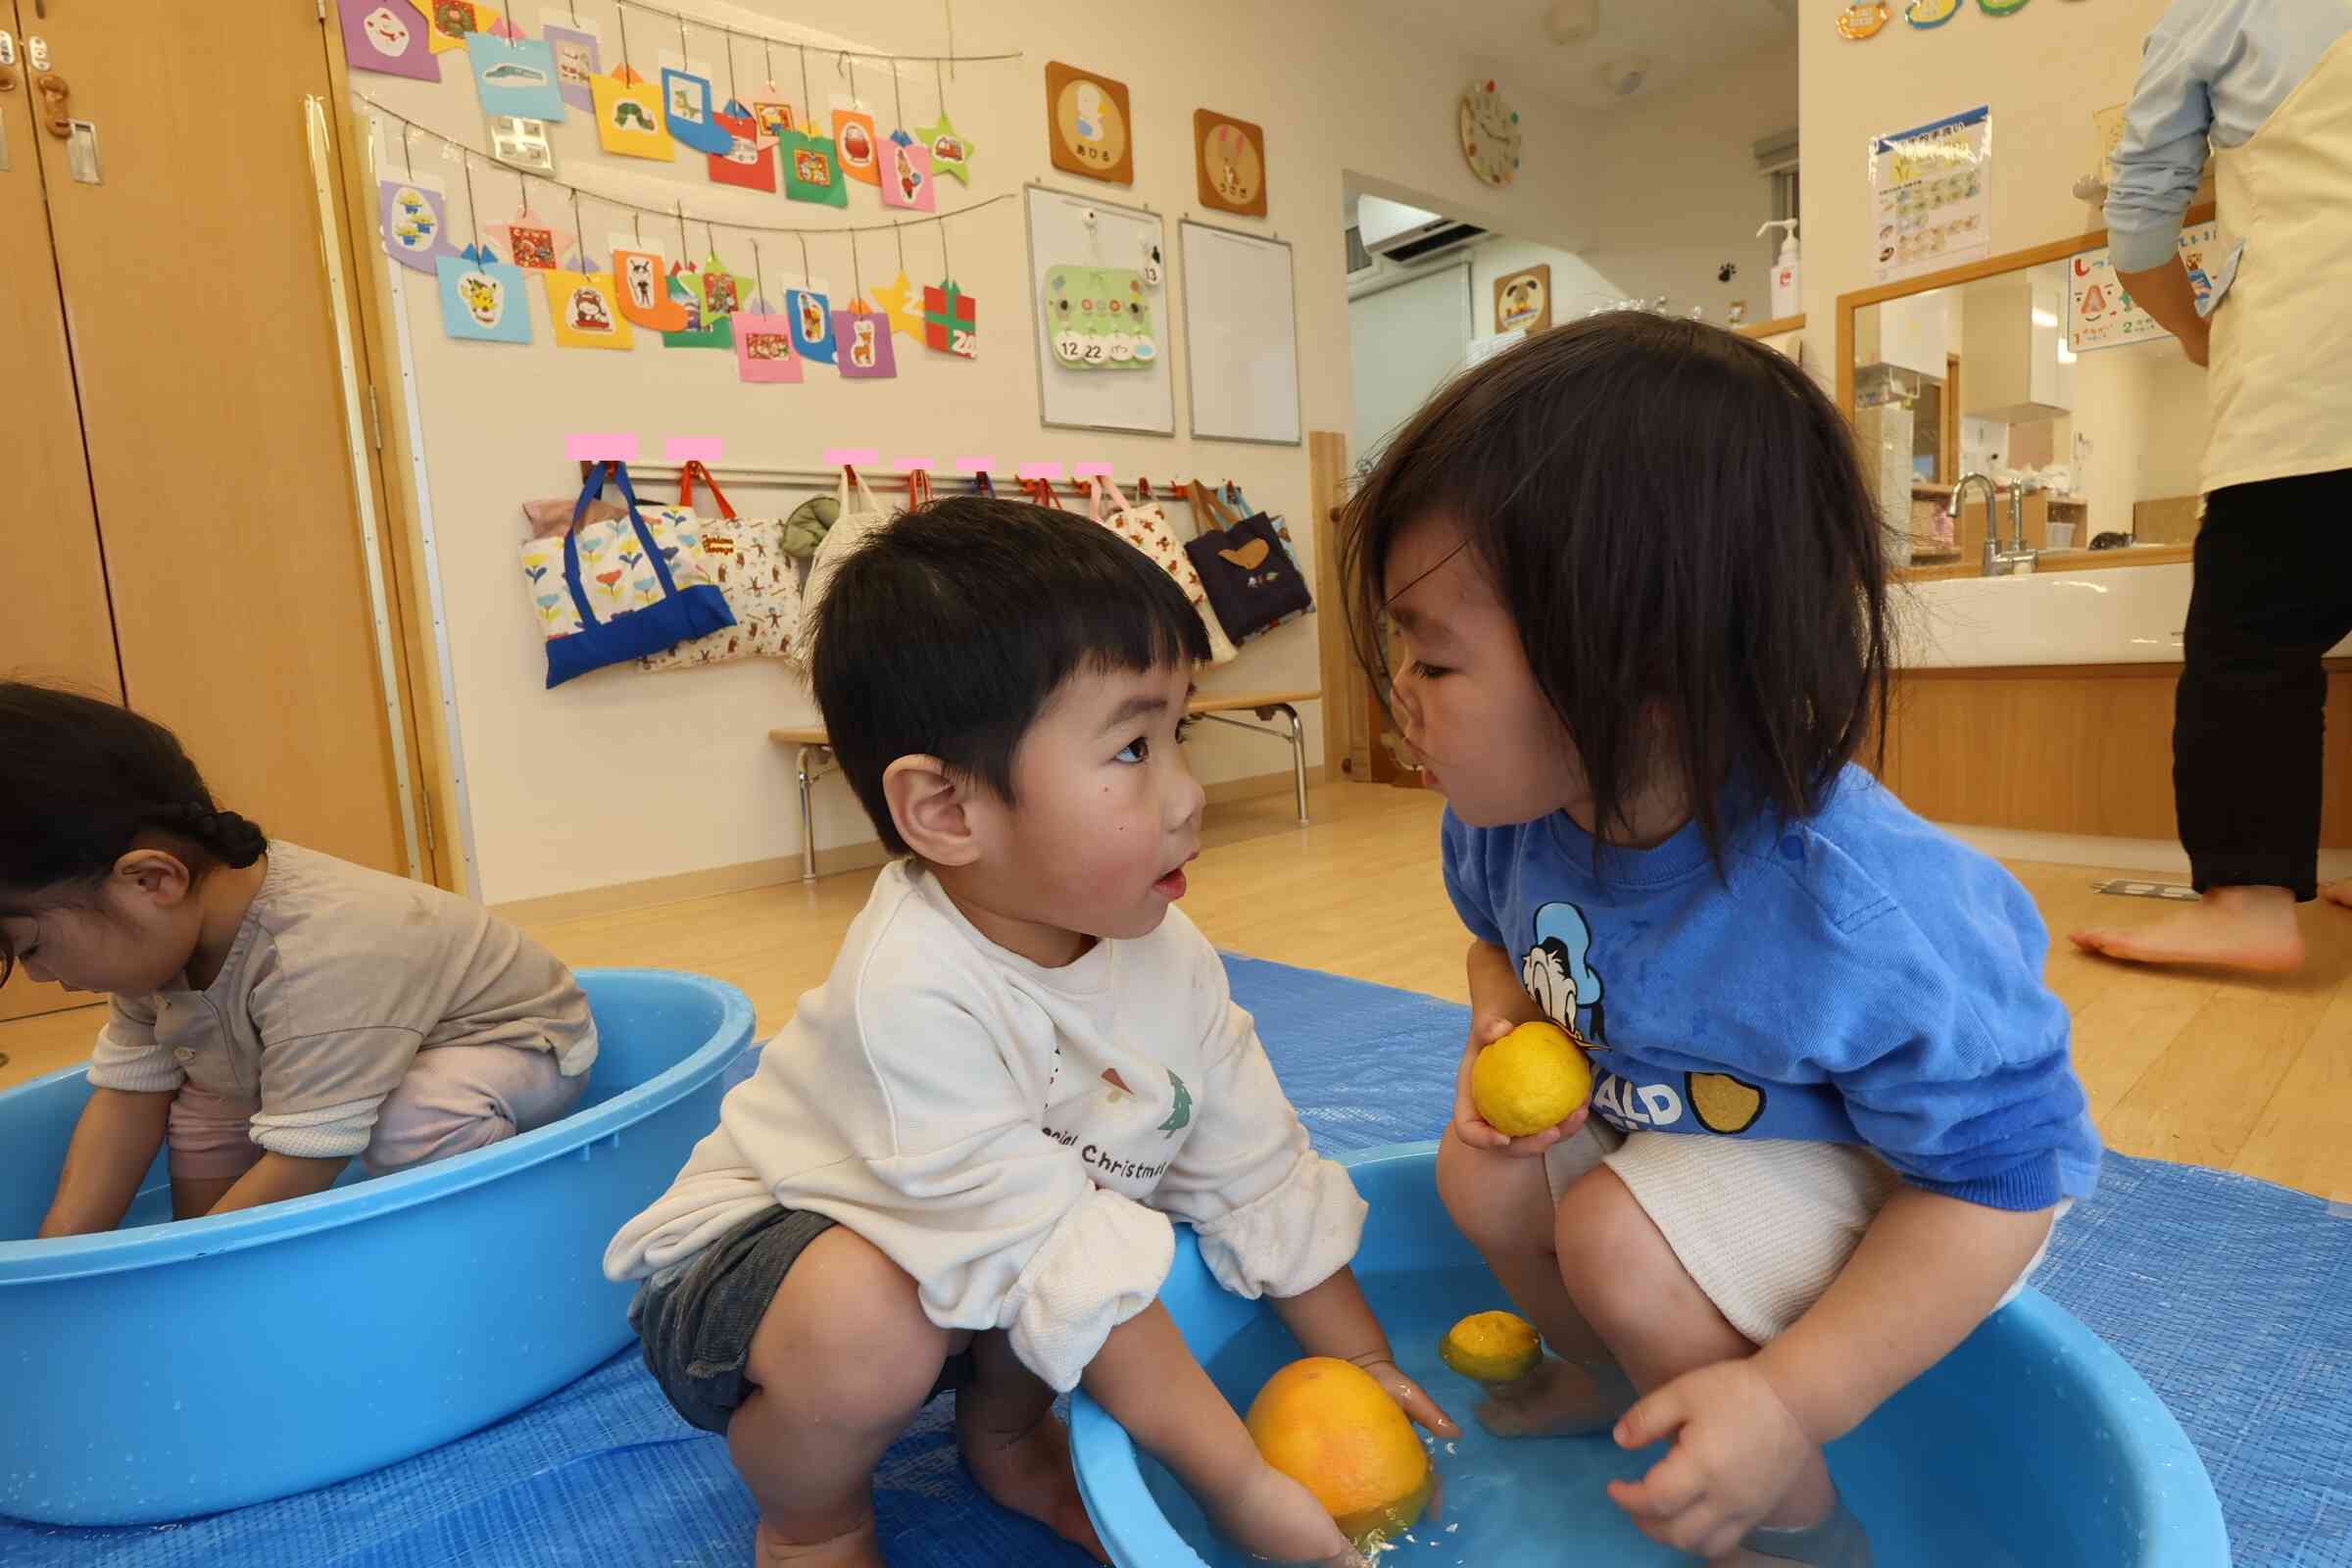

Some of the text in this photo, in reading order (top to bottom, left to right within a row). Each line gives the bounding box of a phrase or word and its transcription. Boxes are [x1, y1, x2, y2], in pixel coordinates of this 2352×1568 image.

[1076, 144, 1109, 162] あひる
[1220, 182, 1248, 199] うさぎ
[1144, 267, 1157, 282] 13
[902, 292, 925, 318] 2
[951, 329, 980, 359] 24
[1061, 341, 1079, 356] 12
[1084, 344, 1102, 359] 22
[1592, 1072, 1684, 1126] ALD
